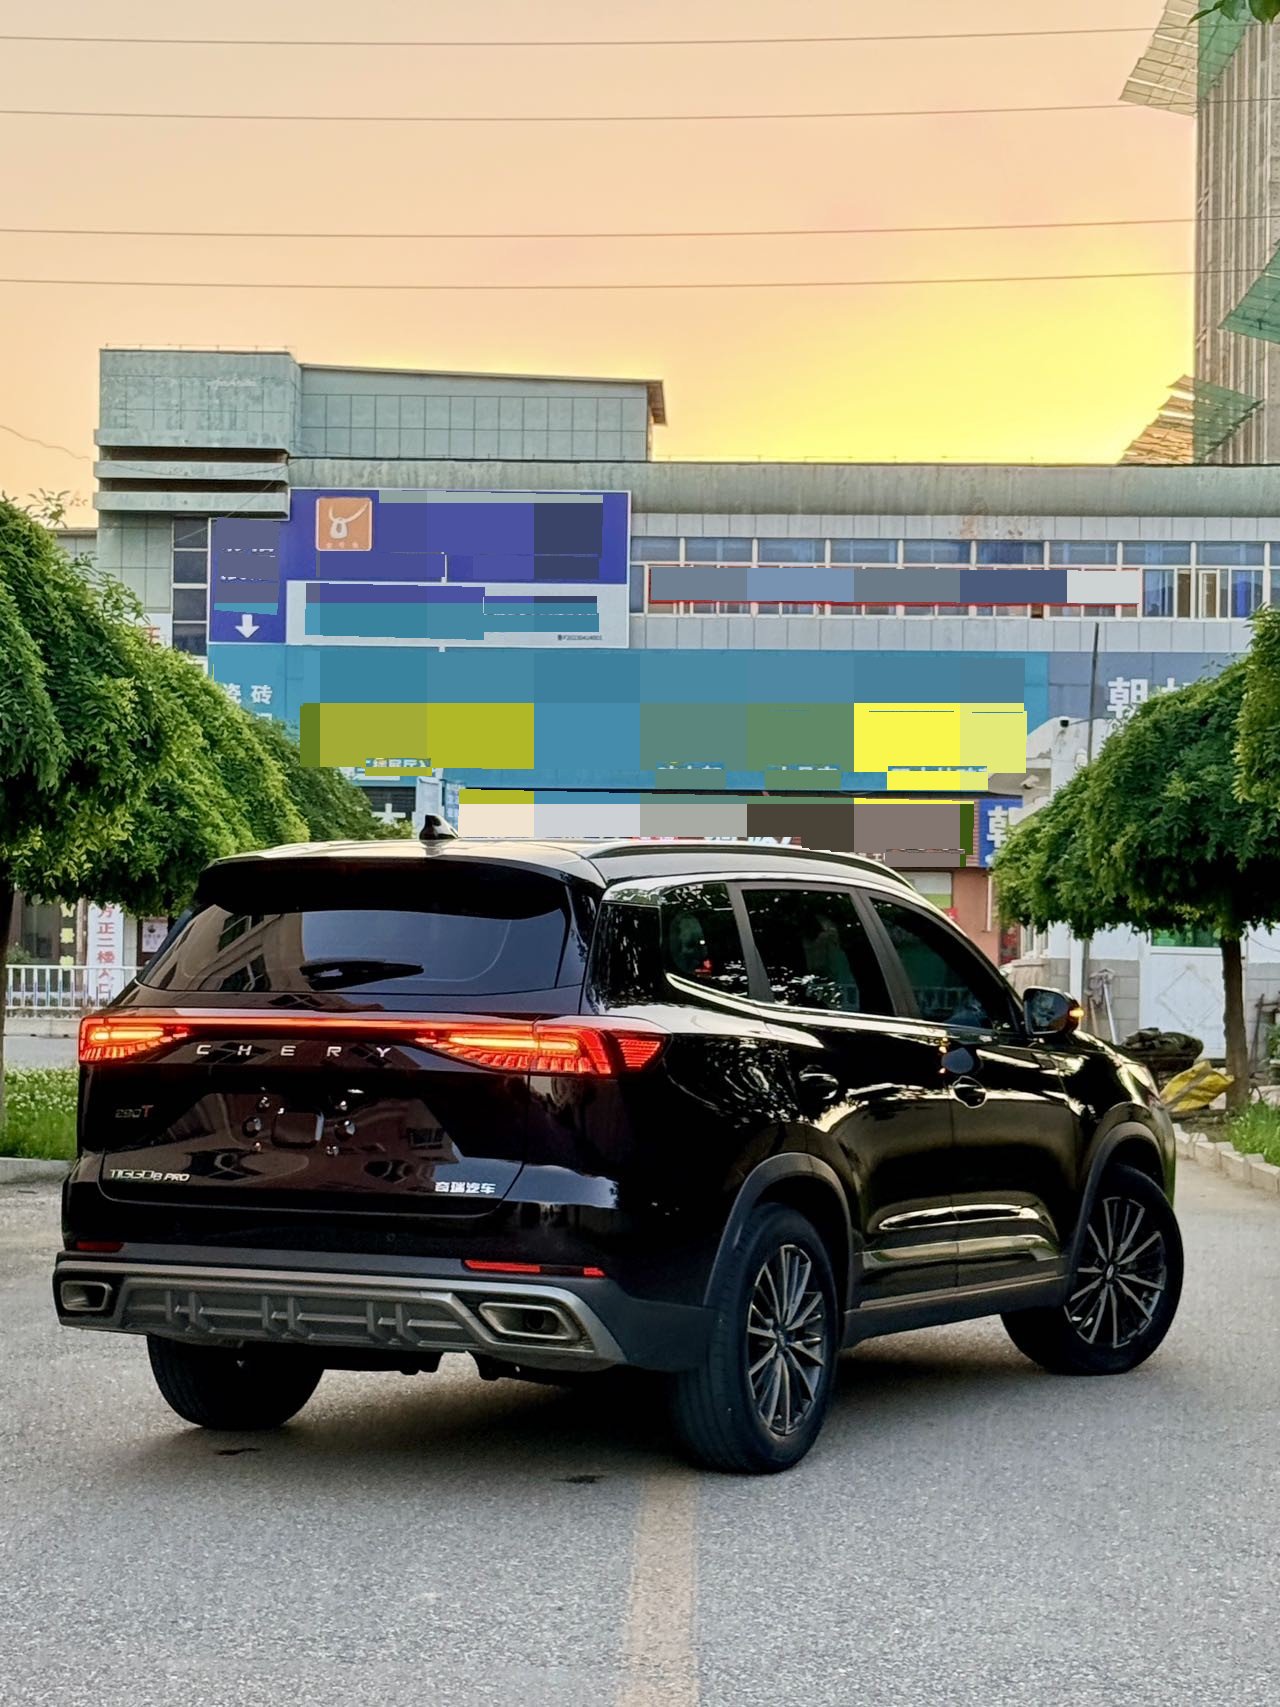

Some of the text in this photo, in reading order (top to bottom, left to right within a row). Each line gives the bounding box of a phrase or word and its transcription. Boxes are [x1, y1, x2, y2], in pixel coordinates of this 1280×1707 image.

[196, 1045, 391, 1058] CHERY
[164, 1173, 190, 1182] PRO
[435, 1181, 496, 1194] 奇瑞汽车
